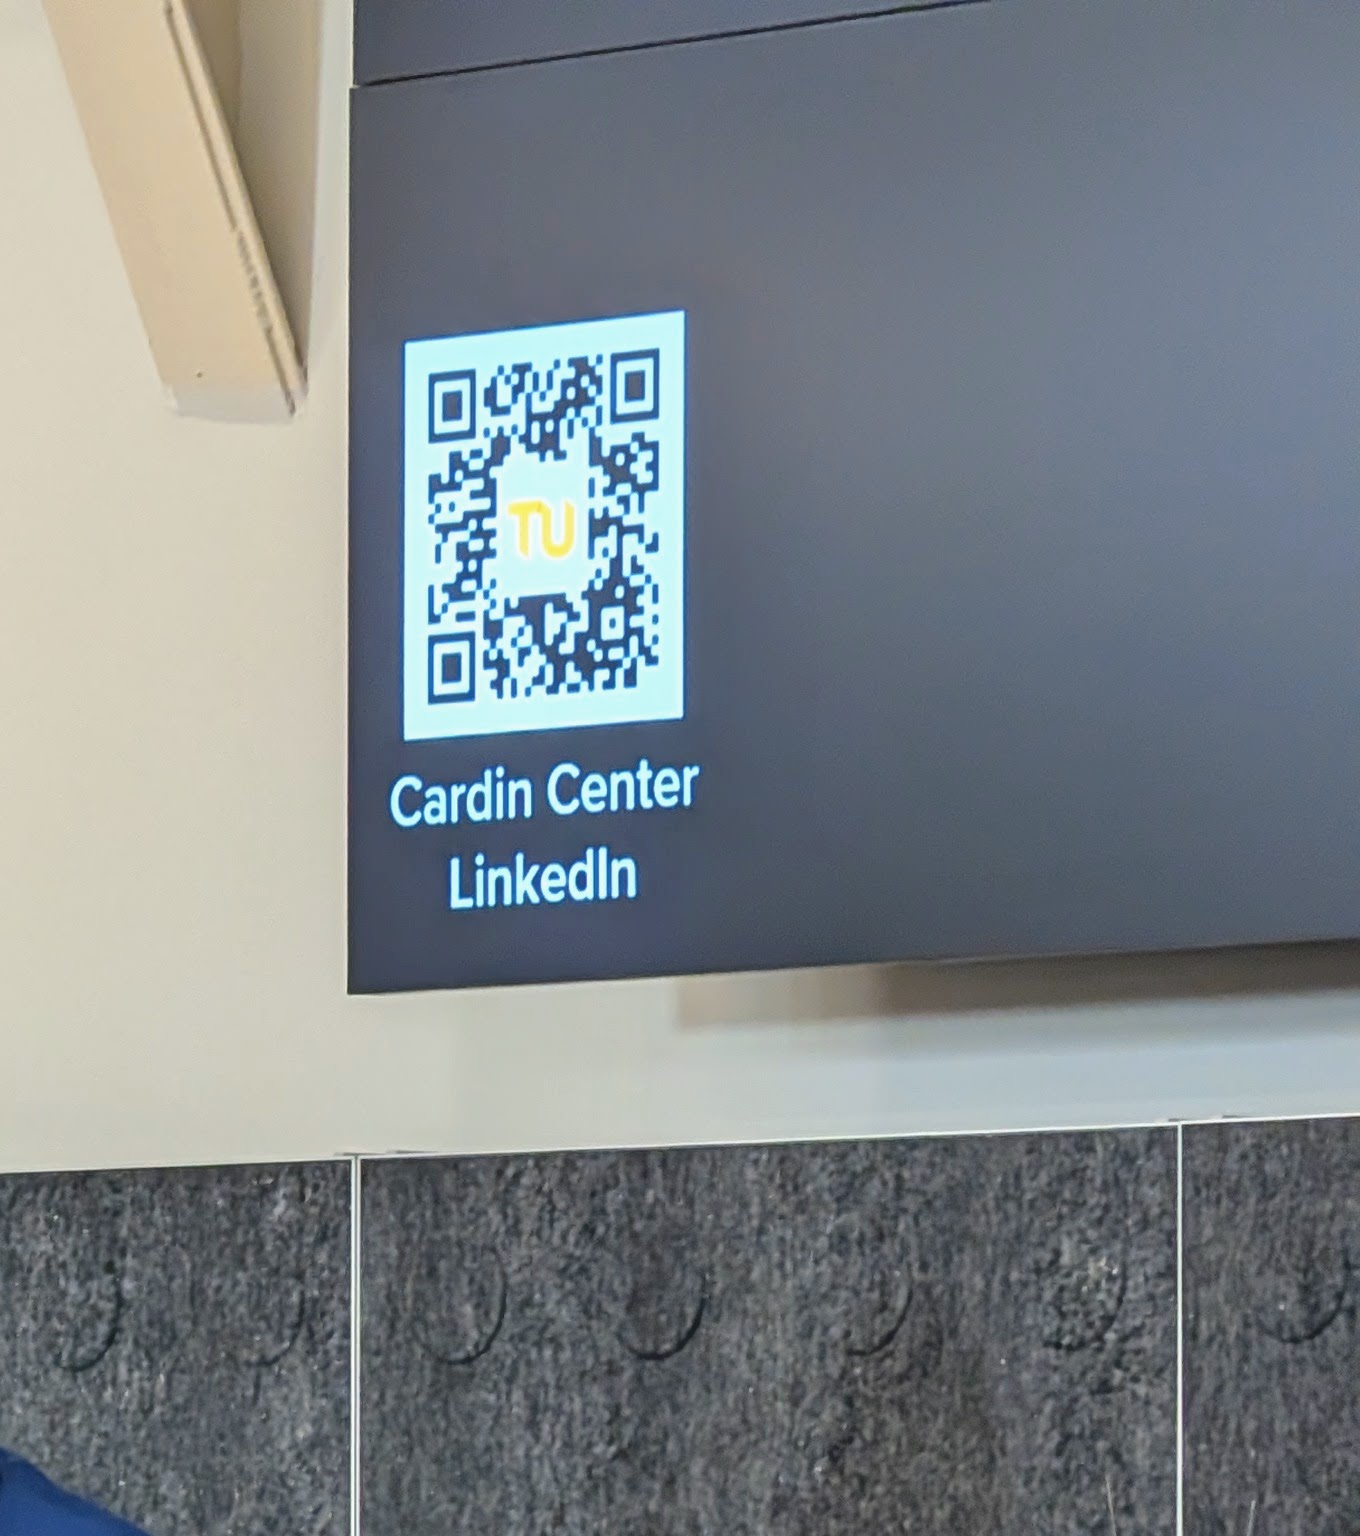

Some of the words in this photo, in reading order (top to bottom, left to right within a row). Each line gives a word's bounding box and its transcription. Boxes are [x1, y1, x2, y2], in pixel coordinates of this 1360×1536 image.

[507, 500, 575, 559] TU
[389, 767, 533, 827] Cardin
[546, 759, 700, 815] Center
[449, 847, 637, 910] LinkedIn
